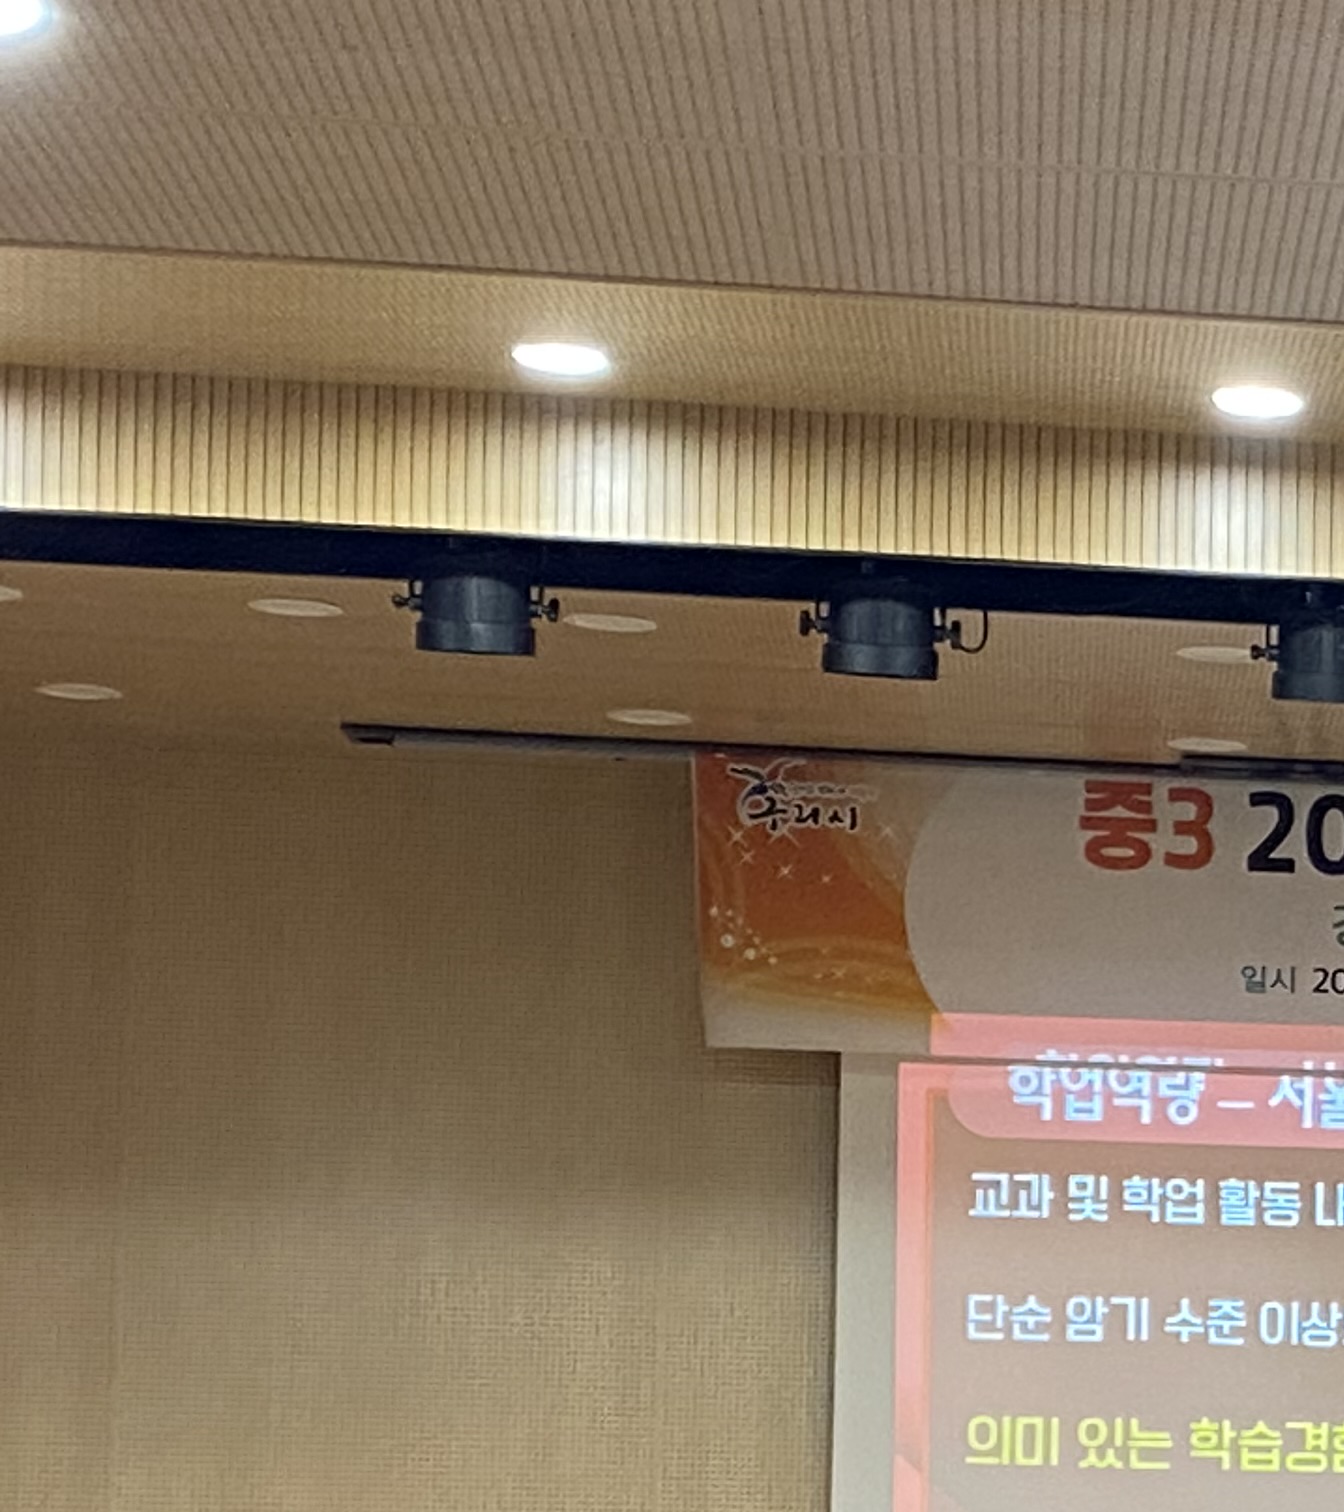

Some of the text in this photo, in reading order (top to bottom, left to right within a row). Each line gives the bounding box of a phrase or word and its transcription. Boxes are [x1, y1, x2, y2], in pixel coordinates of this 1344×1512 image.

[1079, 779, 1215, 872] 중3
[1240, 965, 1297, 995] 일시
[968, 1171, 1054, 1219] 교과
[1067, 1173, 1109, 1223] 및
[1121, 1174, 1205, 1225] 학업
[1218, 1177, 1301, 1228] 활동
[966, 1293, 1052, 1342] 단순
[1065, 1295, 1150, 1343] 암기
[1164, 1297, 1247, 1346] 수준
[965, 1414, 1060, 1468] 의미
[1077, 1416, 1173, 1470] 있는
